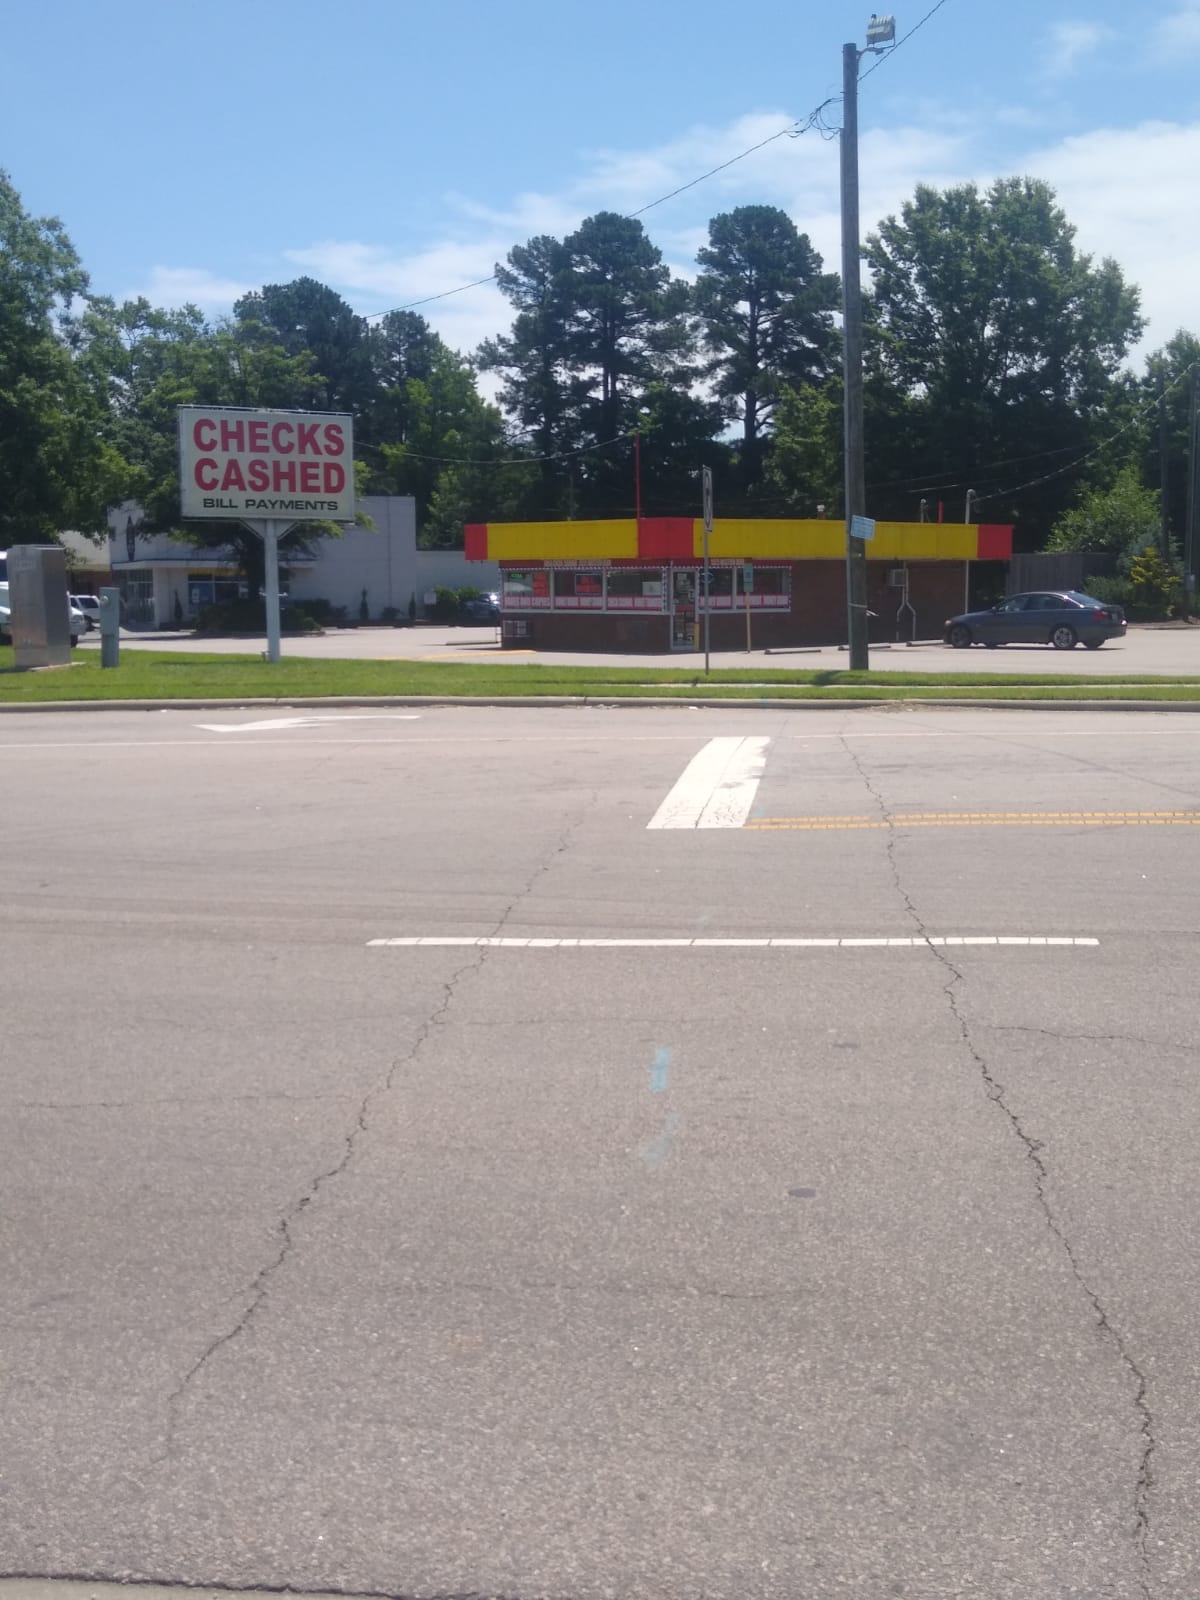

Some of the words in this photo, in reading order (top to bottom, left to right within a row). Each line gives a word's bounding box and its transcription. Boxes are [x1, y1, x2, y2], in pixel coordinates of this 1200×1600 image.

[193, 418, 345, 456] CHECKS
[194, 458, 345, 494] CASHED
[203, 498, 238, 508] BILL
[245, 499, 338, 511] PAYMENTS
